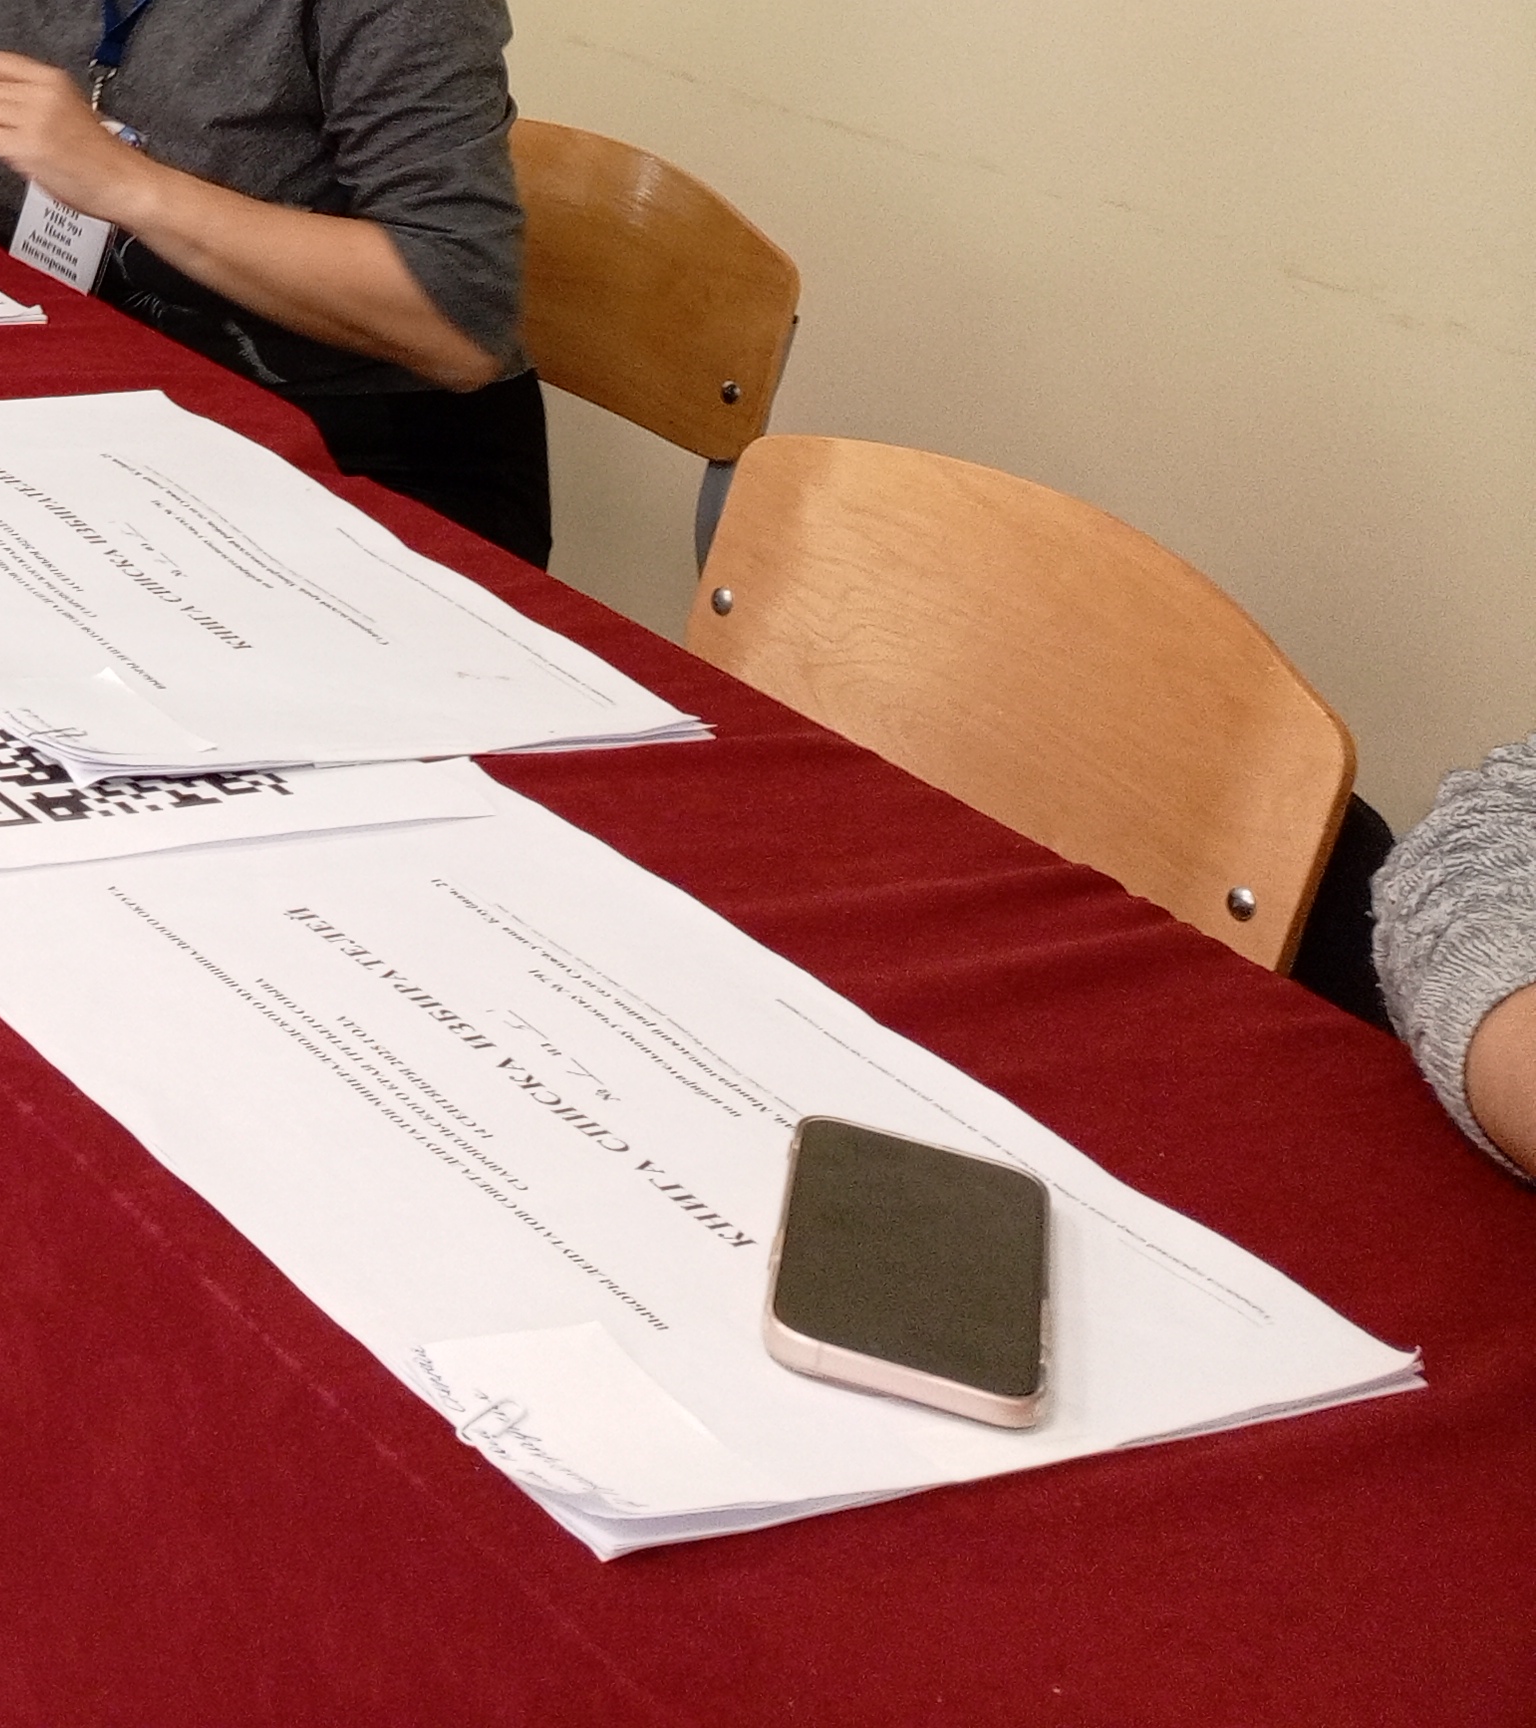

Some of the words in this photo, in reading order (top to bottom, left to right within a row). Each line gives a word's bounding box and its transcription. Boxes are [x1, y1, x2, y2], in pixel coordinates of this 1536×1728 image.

[20, 238, 78, 282] Викторовна
[28, 229, 79, 267] Анастасия
[103, 548, 183, 603] СПИСКА
[180, 605, 253, 650] КНИГА
[283, 907, 497, 1050] ИЗБИРАТЕЛЕЙ
[336, 1015, 376, 1044] ГОДА
[570, 995, 621, 1029] участку
[301, 1015, 364, 1062] ТРЕТЬЕГО
[369, 1045, 405, 1066] 2025
[360, 1064, 399, 1091] КРАЯ
[620, 1030, 724, 1105] избирательному
[398, 1068, 477, 1127] СЕНТЯБРЯ
[496, 1057, 630, 1153] СПИСКА
[595, 1088, 621, 1101] №
[380, 1108, 465, 1167] ДЕПУТАТОВ
[394, 1092, 529, 1191] СТАВРОПОЛЬСКОГО
[473, 1128, 494, 1139] 14
[461, 1168, 518, 1209] СОВЕТА
[635, 1159, 757, 1248] КНИГА
[514, 1210, 605, 1277] ДЕПУТАТОВ
